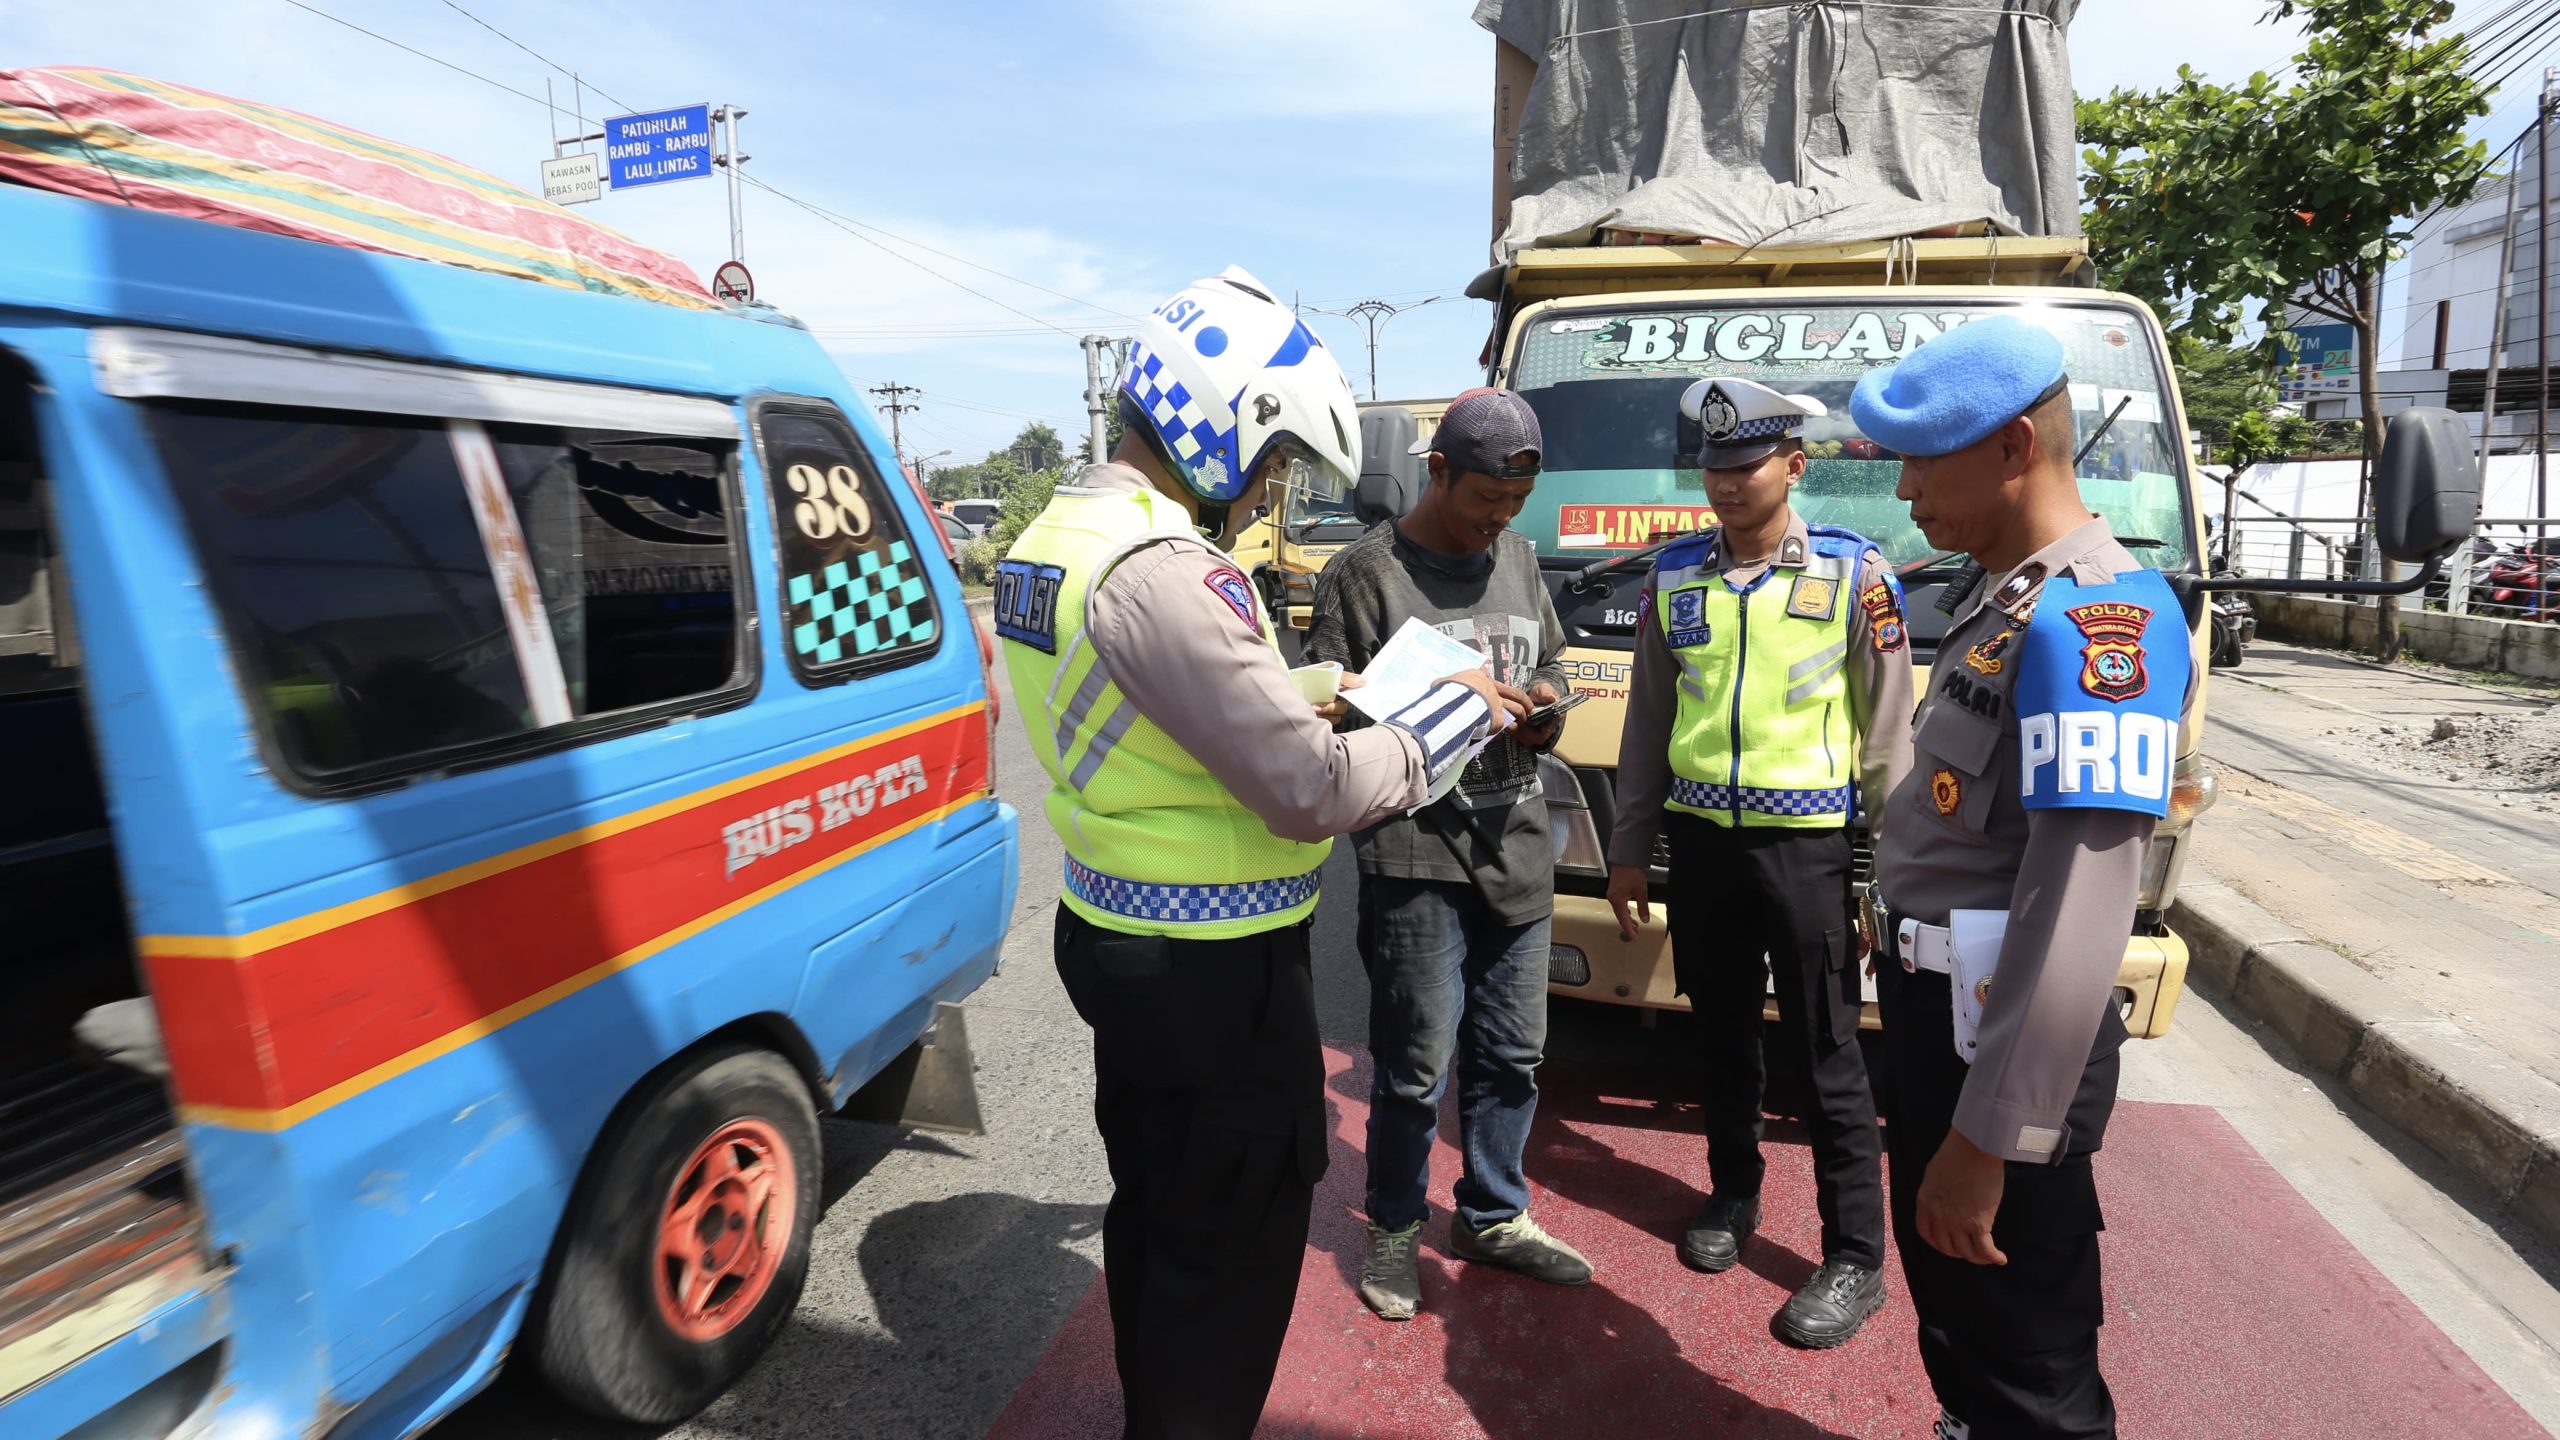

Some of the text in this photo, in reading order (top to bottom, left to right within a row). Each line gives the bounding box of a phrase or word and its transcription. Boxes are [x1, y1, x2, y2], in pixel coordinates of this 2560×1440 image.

[621, 116, 687, 138] PATUHILAH
[609, 141, 651, 160] RAMBU
[665, 132, 708, 152] RAMBU
[550, 163, 592, 179] KAWASAN
[624, 155, 698, 179] LALU LINTAS
[545, 180, 598, 197] BEBAS POOL
[1618, 313, 1985, 363] BIGLAN
[2323, 351, 2351, 369] 24
[786, 464, 872, 540] 38
[1571, 510, 1586, 524] LS
[2078, 604, 2141, 621] POLDA
[1941, 668, 2001, 719] POLRI
[2020, 710, 2178, 804] PRO
[721, 753, 929, 877] BUS KOTA
